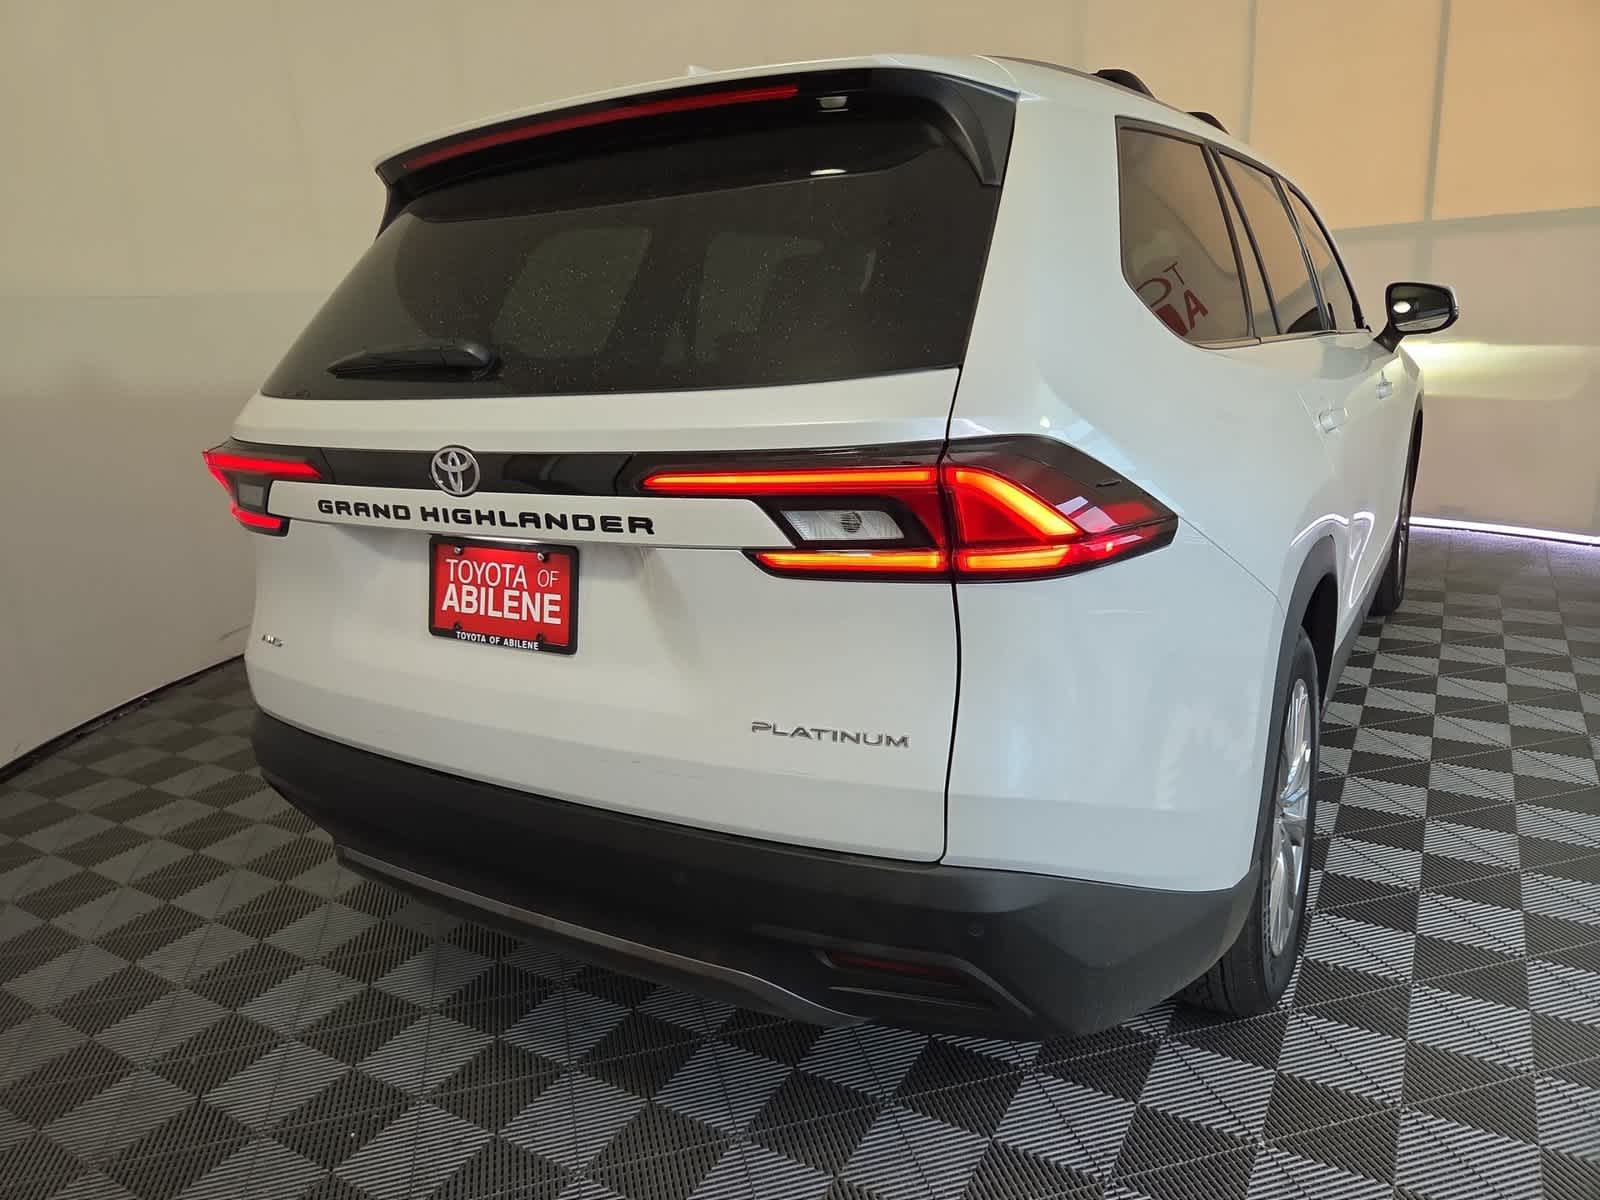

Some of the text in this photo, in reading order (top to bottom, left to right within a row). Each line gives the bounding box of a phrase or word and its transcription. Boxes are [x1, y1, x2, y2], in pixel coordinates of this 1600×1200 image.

[317, 499, 655, 535] GRAND HIGHLANDER
[446, 559, 559, 589] TOYOTA OF
[441, 584, 561, 625] ABILENE
[456, 631, 539, 650] TOYOTA OF ABILENE
[751, 721, 909, 748] PLATINUM
